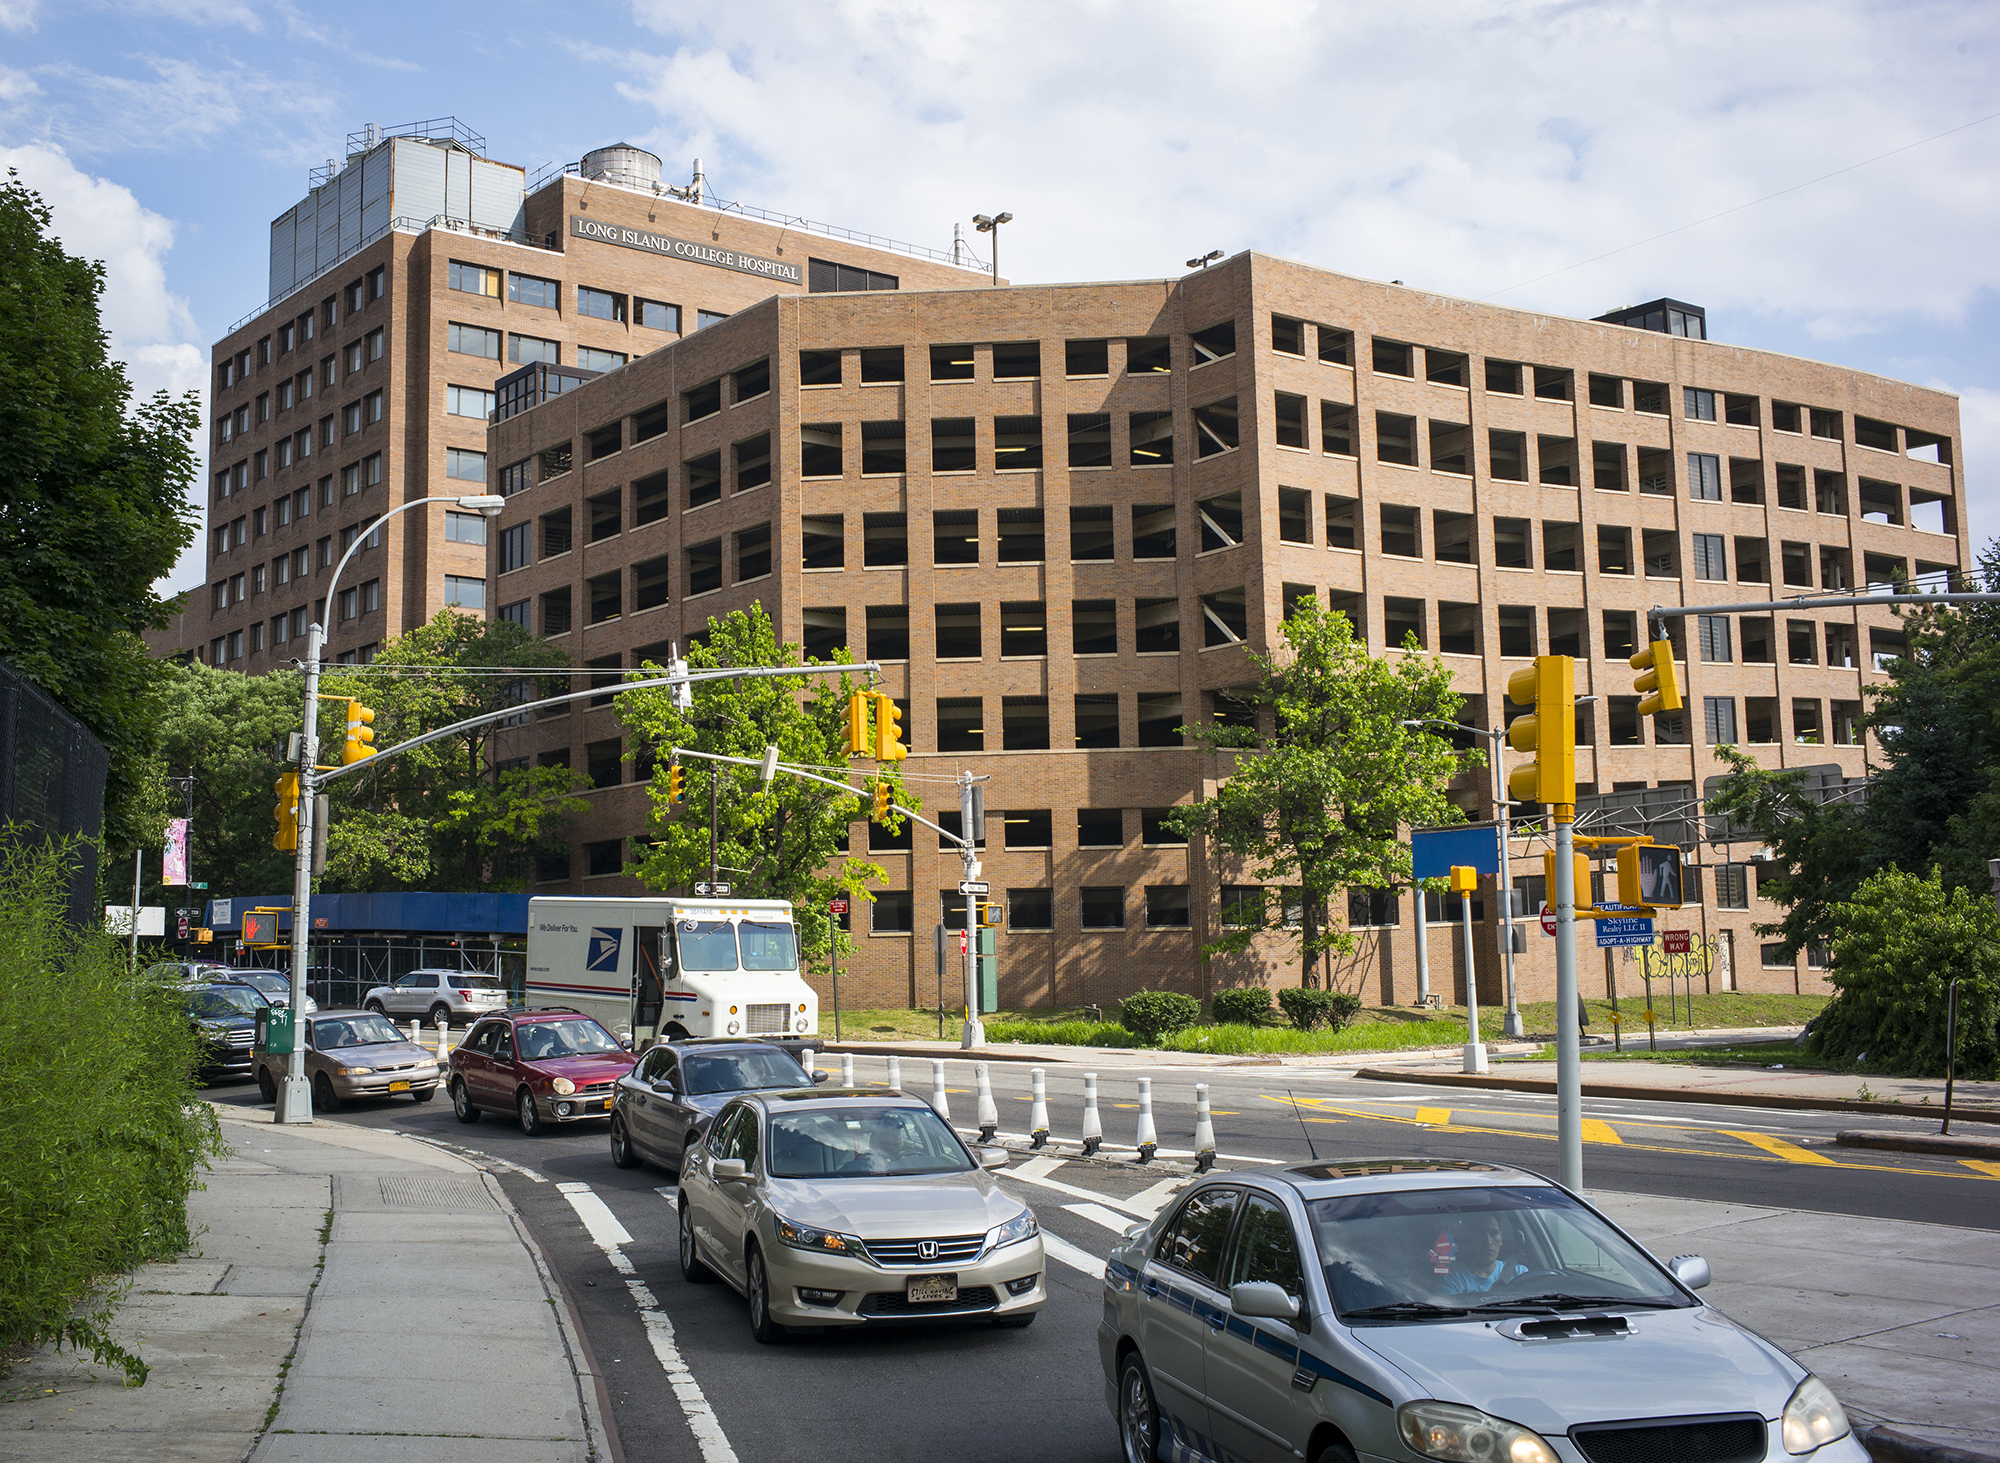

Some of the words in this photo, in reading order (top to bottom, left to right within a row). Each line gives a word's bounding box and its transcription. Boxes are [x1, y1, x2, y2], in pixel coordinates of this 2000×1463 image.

[577, 219, 618, 241] LONG
[620, 229, 671, 251] ISLAND
[674, 241, 734, 267] COLLEGE
[737, 255, 799, 281] HOSPITAL
[1607, 917, 1639, 927] Skyline
[547, 923, 562, 932] Deliver
[1602, 925, 1622, 934] Realty
[1623, 924, 1639, 932] LLC
[1664, 932, 1689, 941] WRONG
[1669, 942, 1685, 951] WAY
[911, 1287, 928, 1298] STILL
